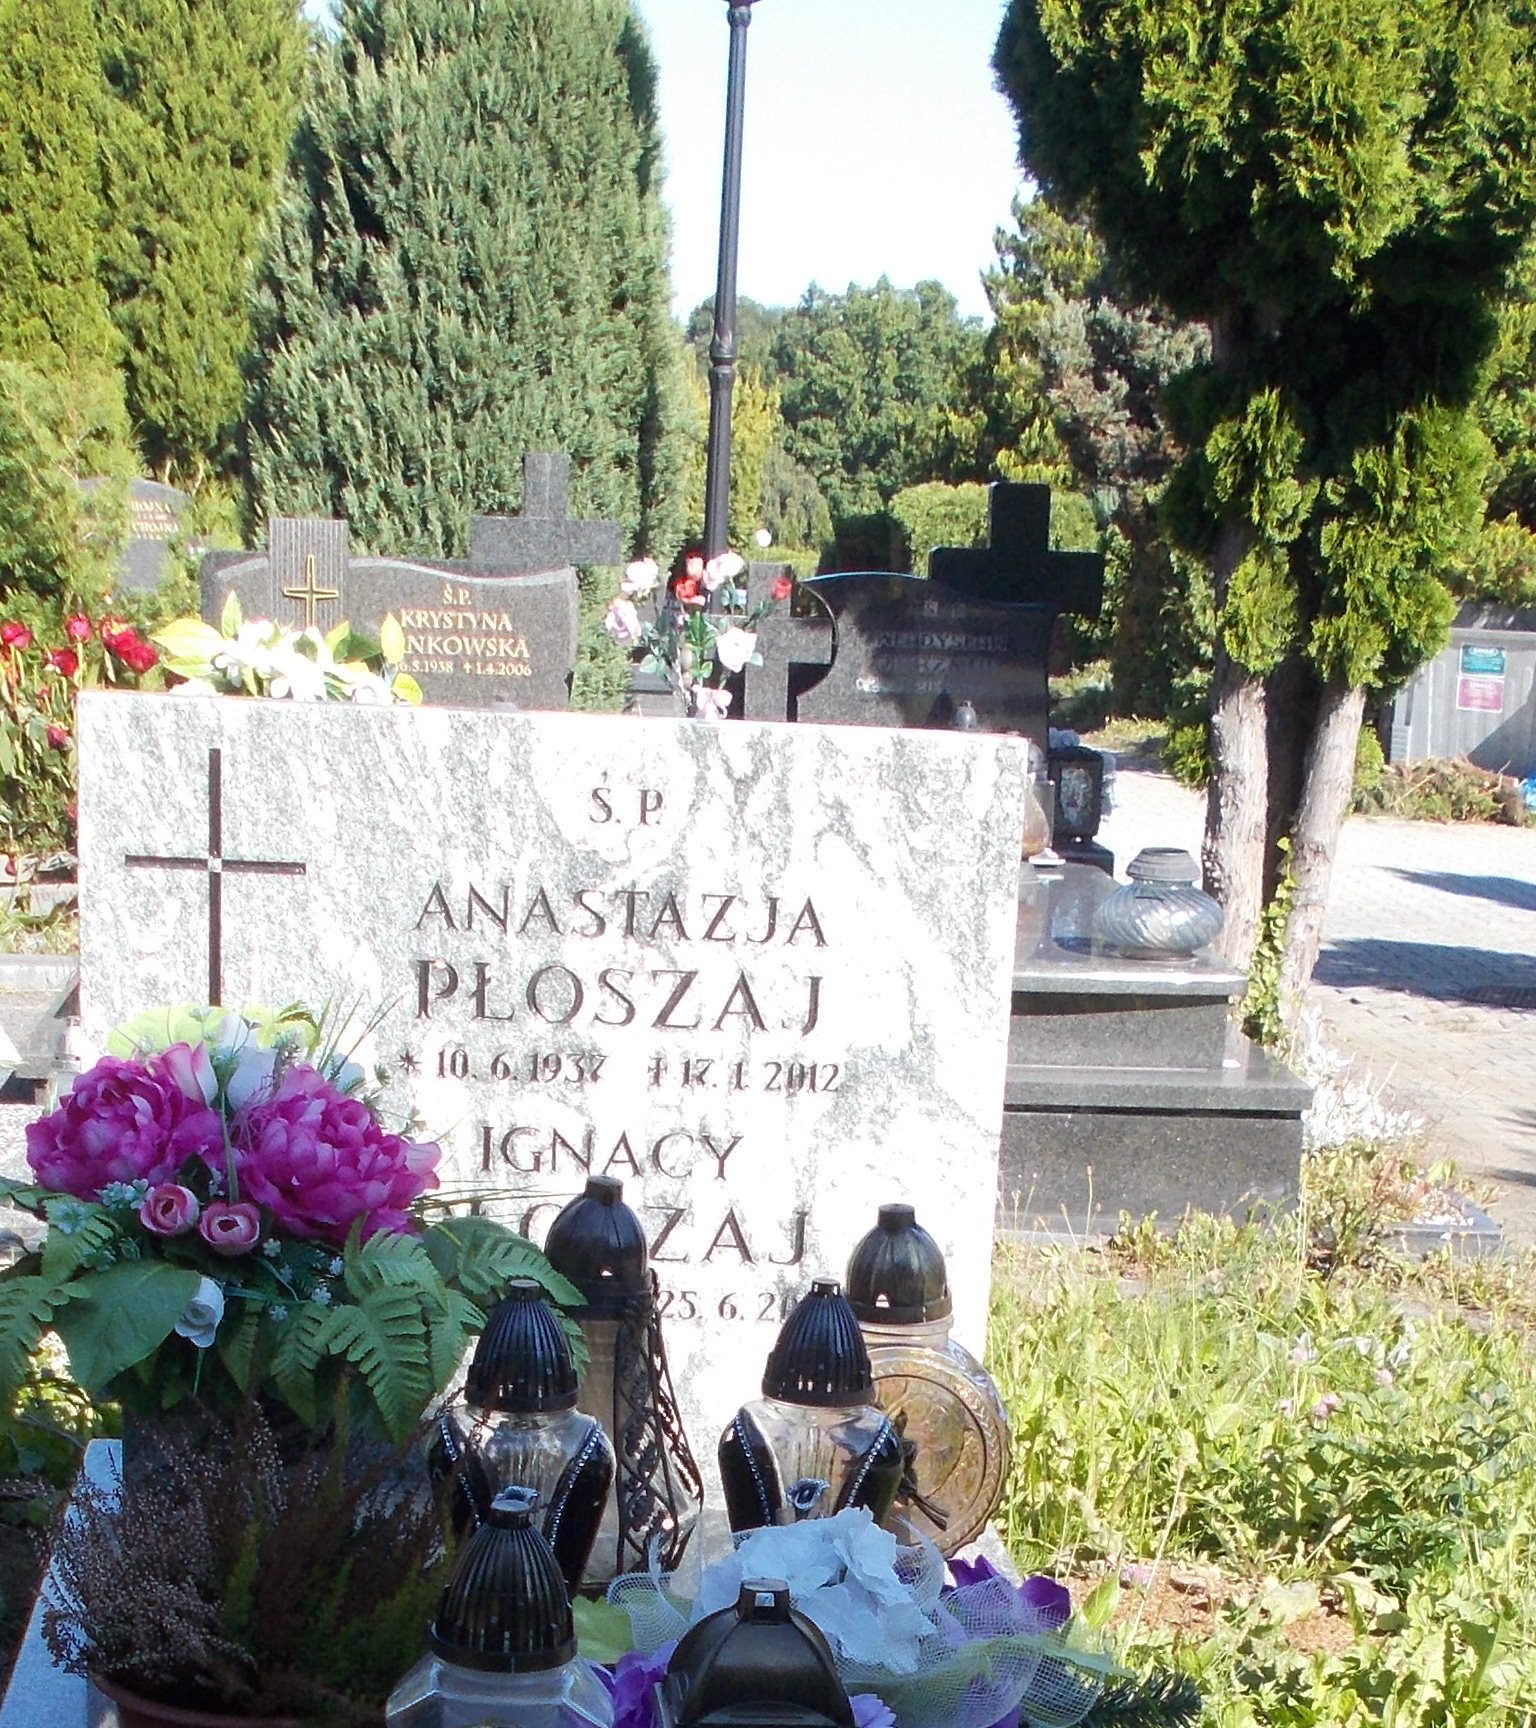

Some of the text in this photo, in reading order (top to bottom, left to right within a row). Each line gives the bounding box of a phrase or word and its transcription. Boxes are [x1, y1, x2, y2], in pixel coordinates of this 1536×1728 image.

[399, 608, 514, 632] KRYSTYNA
[412, 881, 830, 947] ANASTAZJA
[415, 958, 824, 1036] PŁOSZAJ
[480, 1123, 744, 1182] IGNACY
